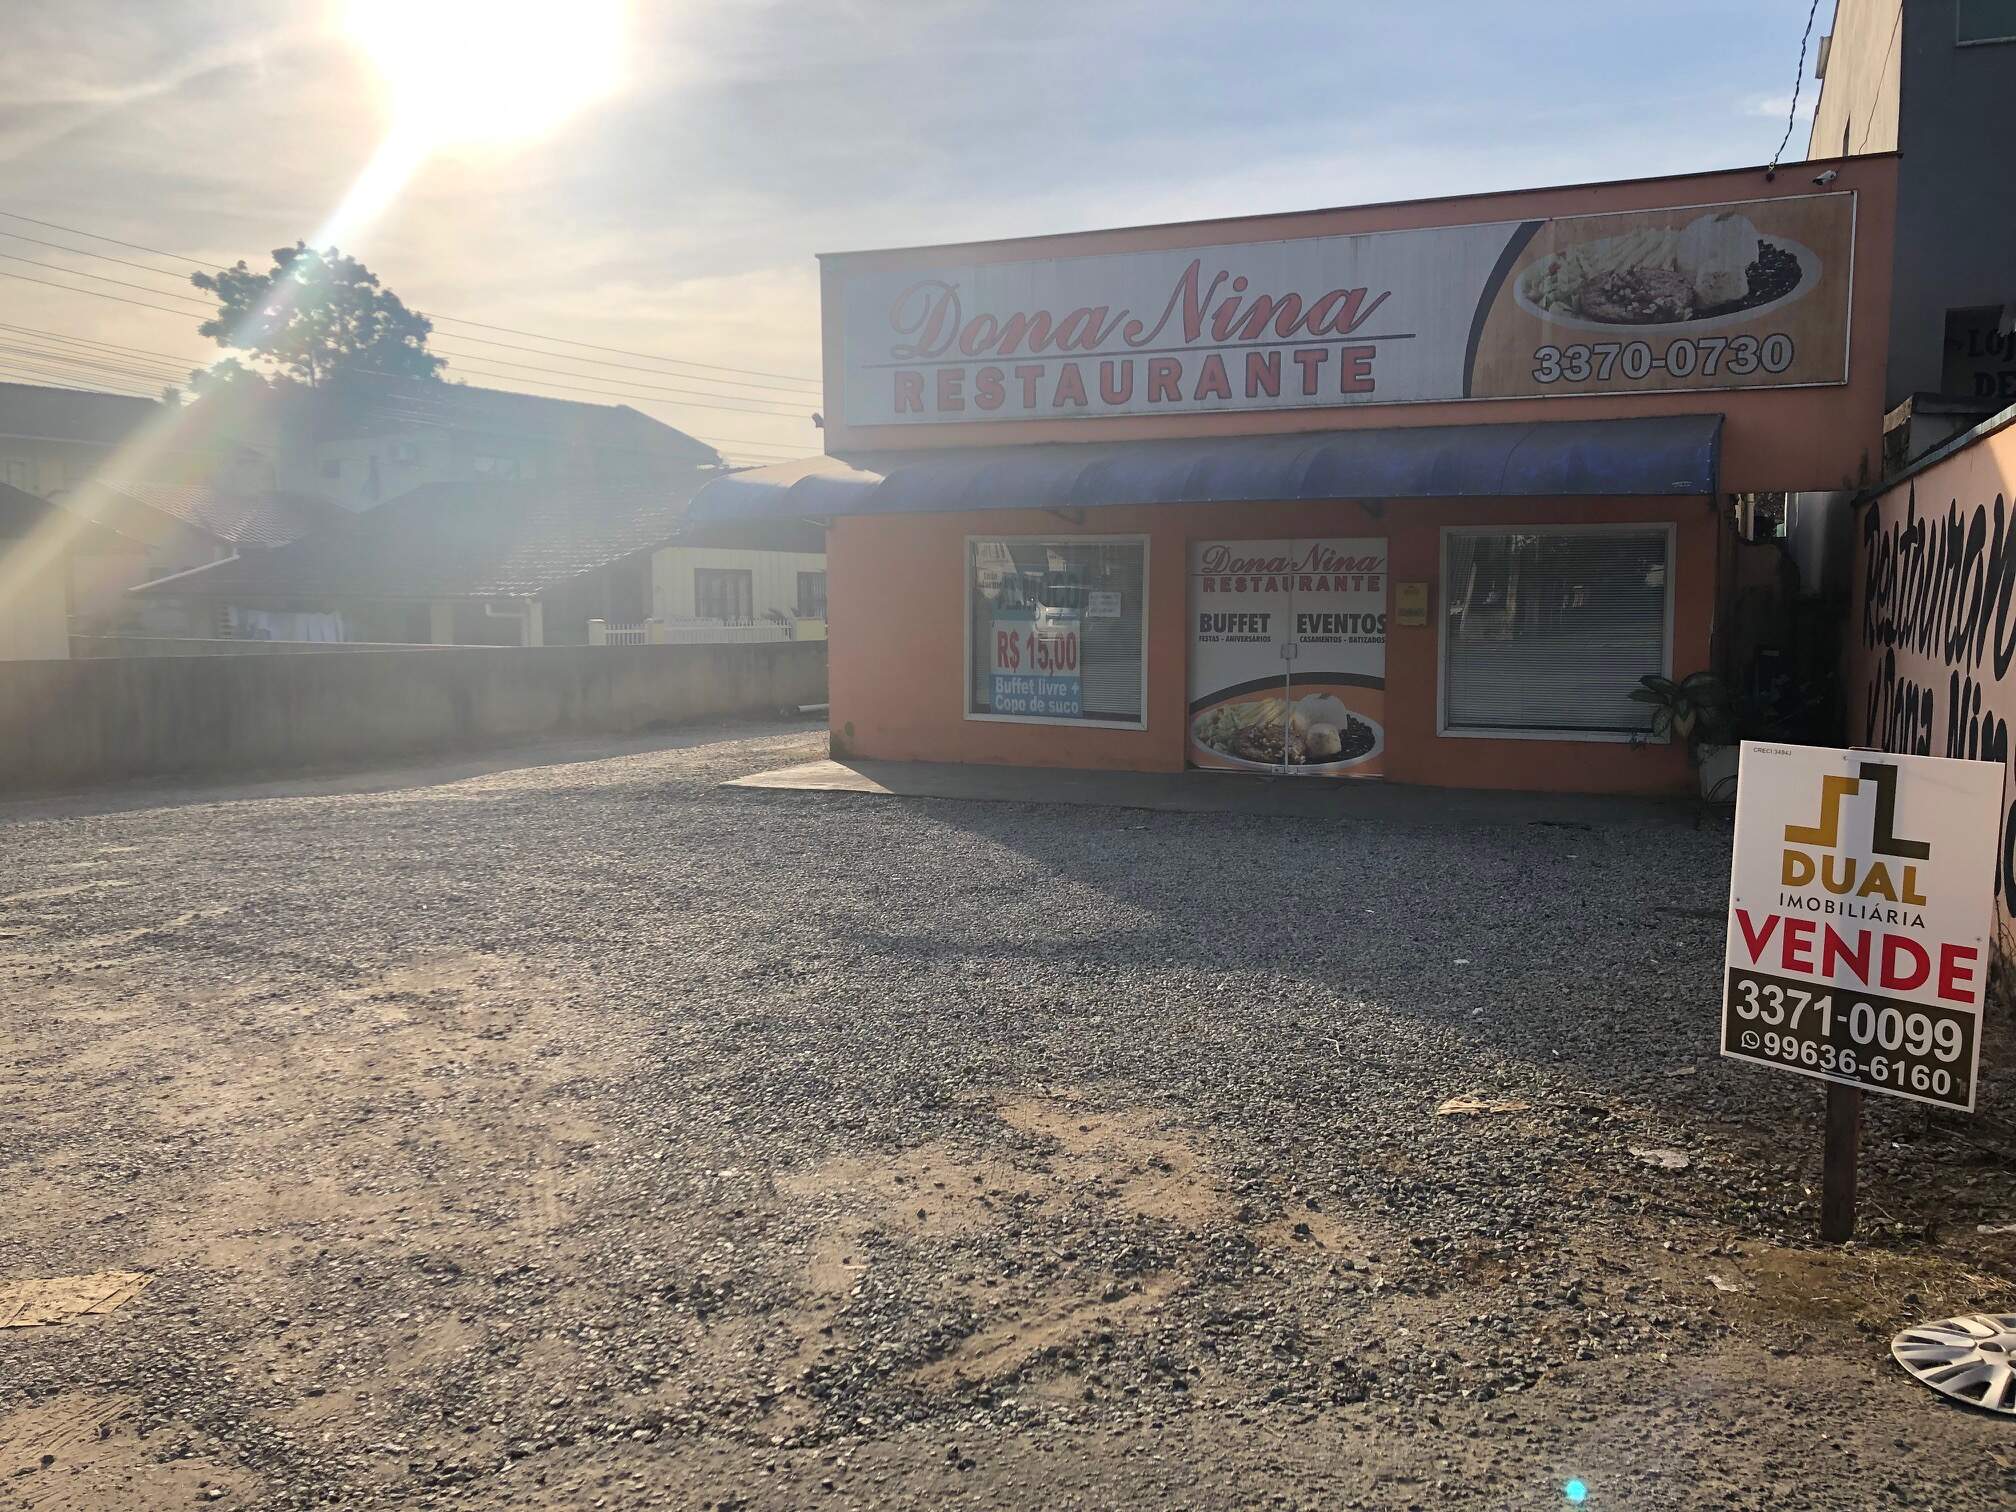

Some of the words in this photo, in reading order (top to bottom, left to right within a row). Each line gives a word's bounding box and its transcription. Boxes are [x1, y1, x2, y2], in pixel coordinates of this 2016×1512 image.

[889, 279, 1129, 359] Dona
[1124, 258, 1392, 349] Nina
[893, 346, 1377, 413] RESTAURANTE
[1531, 333, 1794, 384] 3370-0730
[1202, 545, 1289, 573] Dona
[1290, 543, 1385, 573] Nina
[1202, 575, 1381, 593] RESTAURANTE
[1199, 613, 1271, 634] BUFFET
[1297, 613, 1387, 635] EVENTOS
[997, 628, 1020, 673] R$
[1026, 631, 1077, 677] 15,00
[995, 677, 1035, 695] Buffet
[1039, 678, 1067, 696] livre
[1030, 695, 1046, 711] de
[1048, 700, 1079, 714] suco
[1781, 848, 1927, 907] DUAL
[1779, 892, 1926, 929] IMOBILIÁRIA
[1735, 908, 1978, 1004] VENDE
[1736, 979, 1963, 1063] 3371-0099
[1763, 1031, 1952, 1096] 99636-6160
